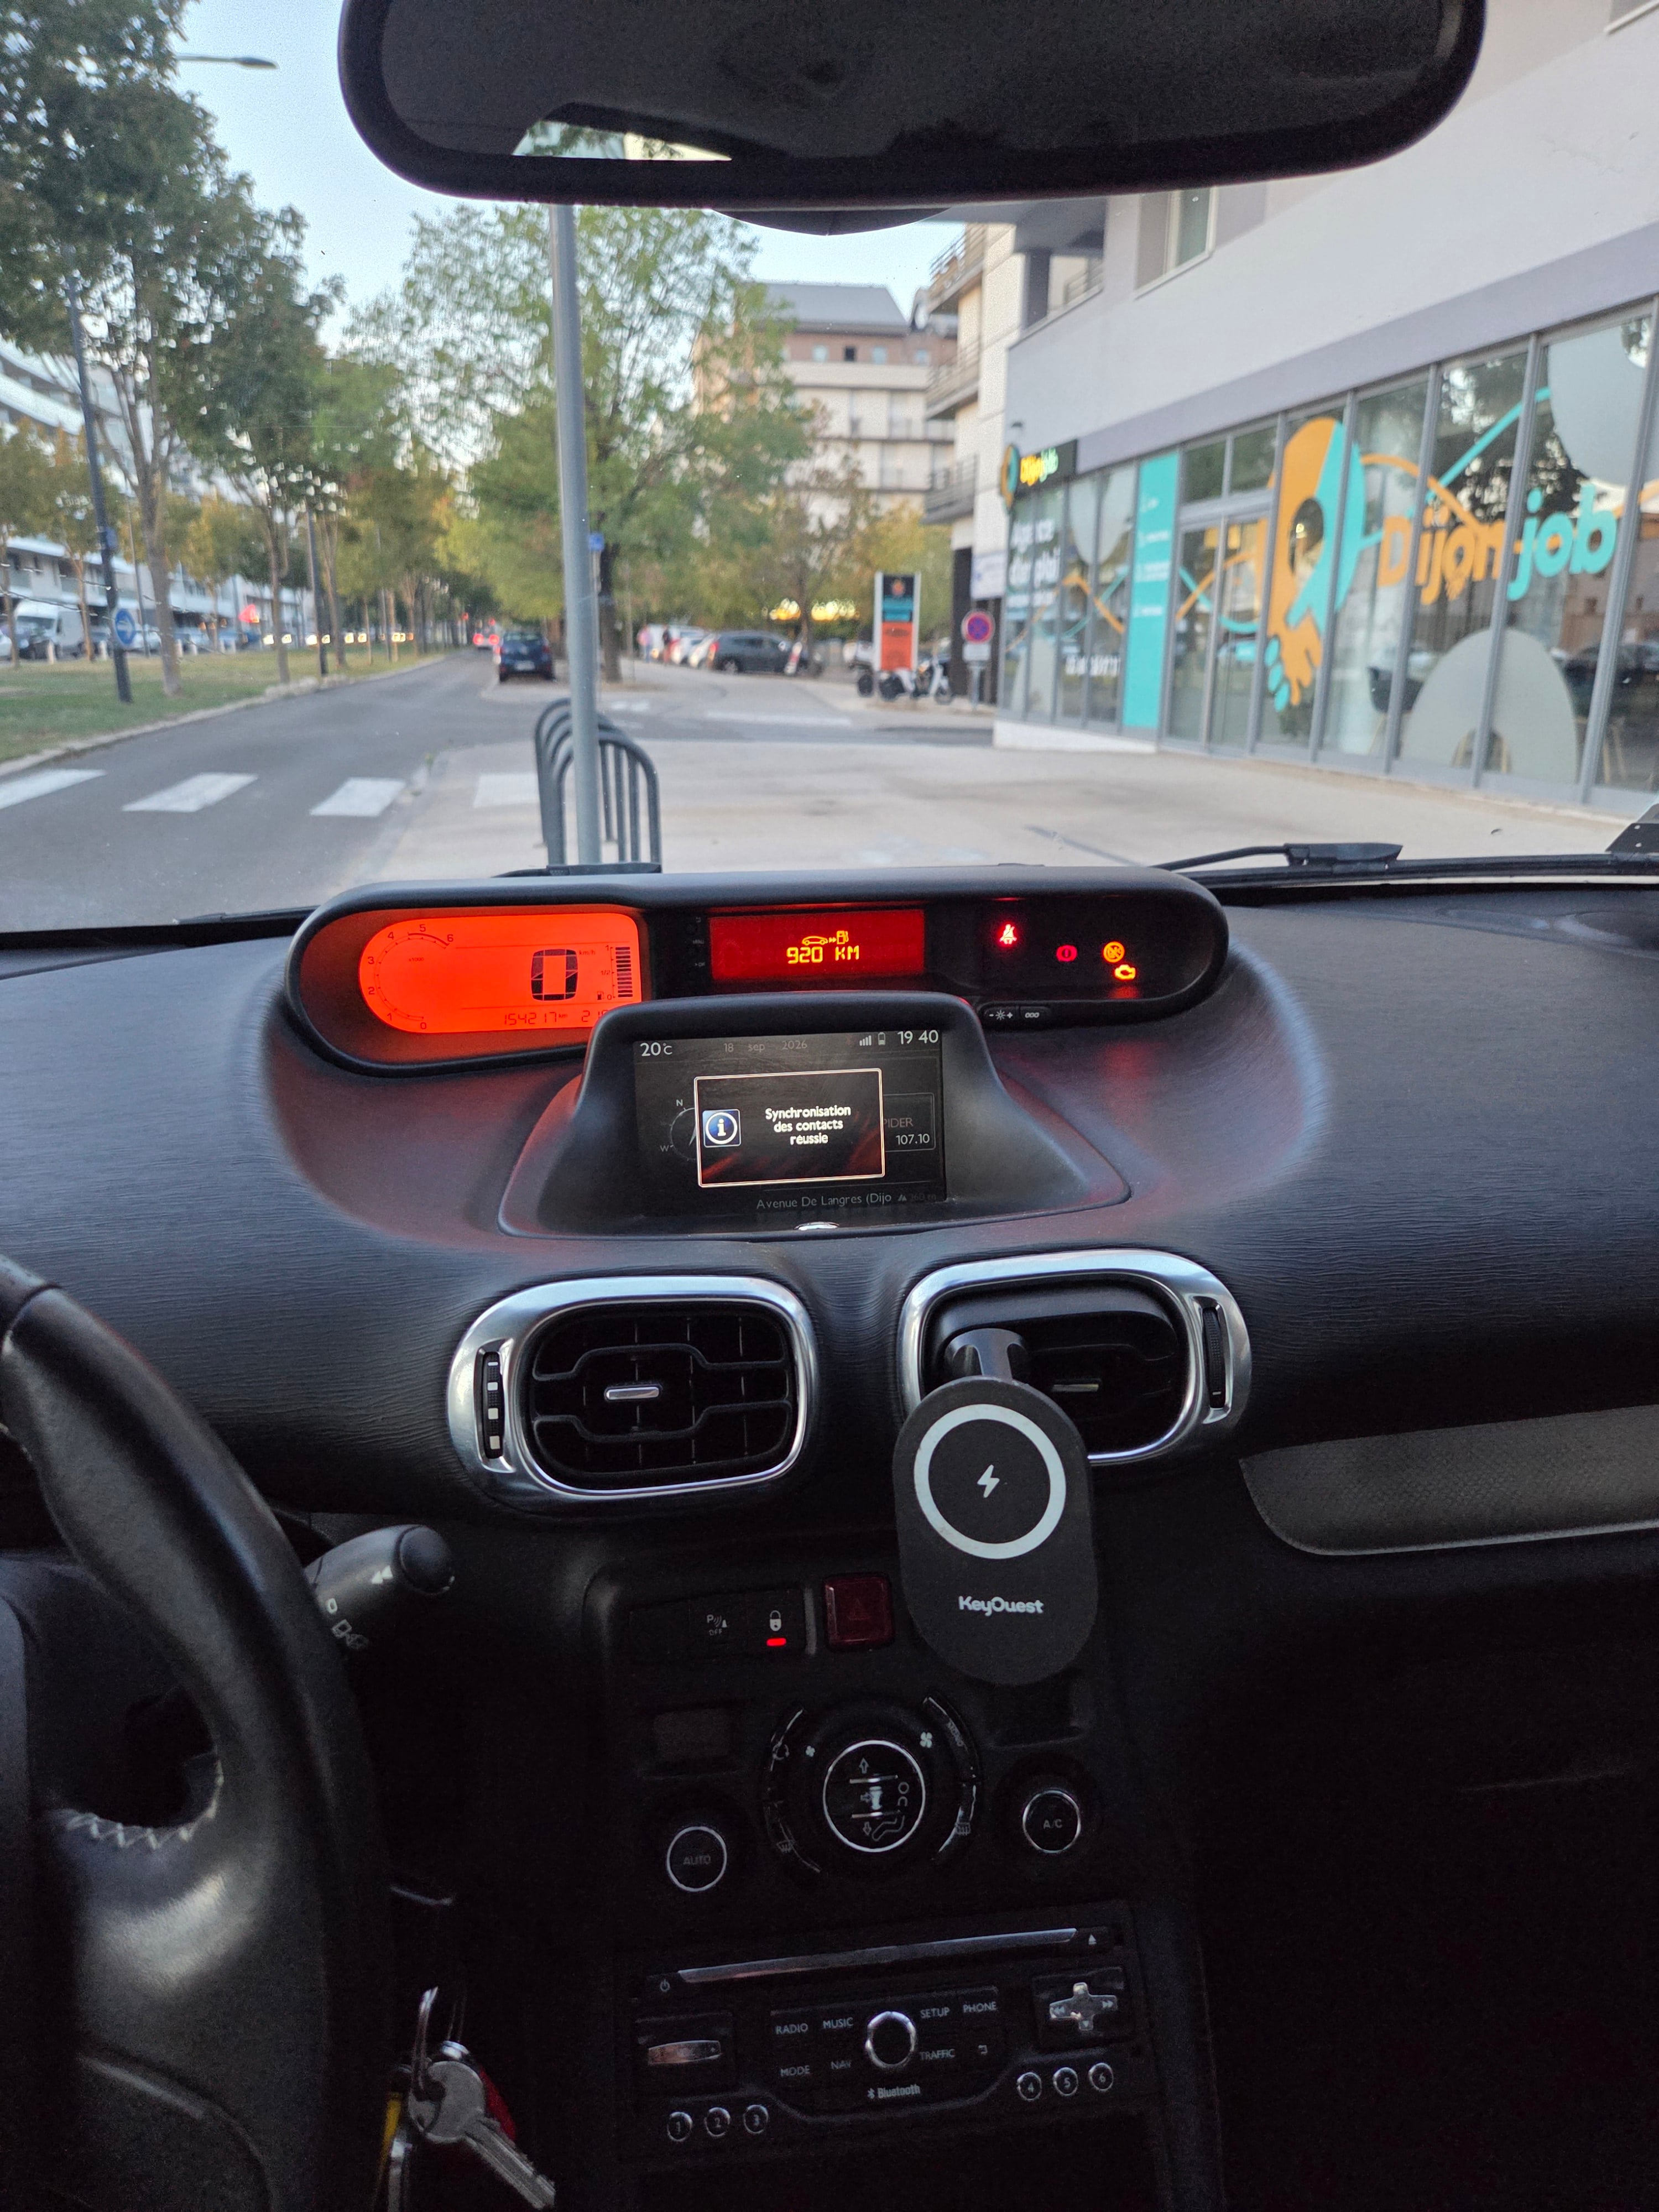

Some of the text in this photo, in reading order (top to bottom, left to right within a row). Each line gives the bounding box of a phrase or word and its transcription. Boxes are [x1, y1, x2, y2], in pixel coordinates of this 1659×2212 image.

[419, 924, 426, 932] 5
[388, 932, 394, 940] 4
[447, 934, 453, 942] 6
[786, 945, 859, 964] 920 KM
[531, 949, 578, 1001] 0
[368, 987, 375, 995] 2
[504, 1012, 557, 1025] 154217
[724, 1040, 808, 1053] 18 sep 2026
[765, 1105, 851, 1122] Synchronisation
[774, 1119, 844, 1133] des contacts
[790, 1132, 828, 1145] réussie
[895, 1133, 930, 1145] 107.10
[757, 1193, 892, 1209] Avenue De Langres (Dijo
[1043, 1818, 1063, 1830] A/C
[682, 1854, 711, 1865] AUTO
[920, 2001, 997, 2019] SETUP PHONE
[776, 2017, 854, 2034] RADIO MUSIC
[920, 2048, 956, 2060] TRAFFIC
[780, 2065, 810, 2077] MODE
[1027, 2073, 1106, 2093] 4 5 6
[877, 2084, 921, 2099] Bluetooth
